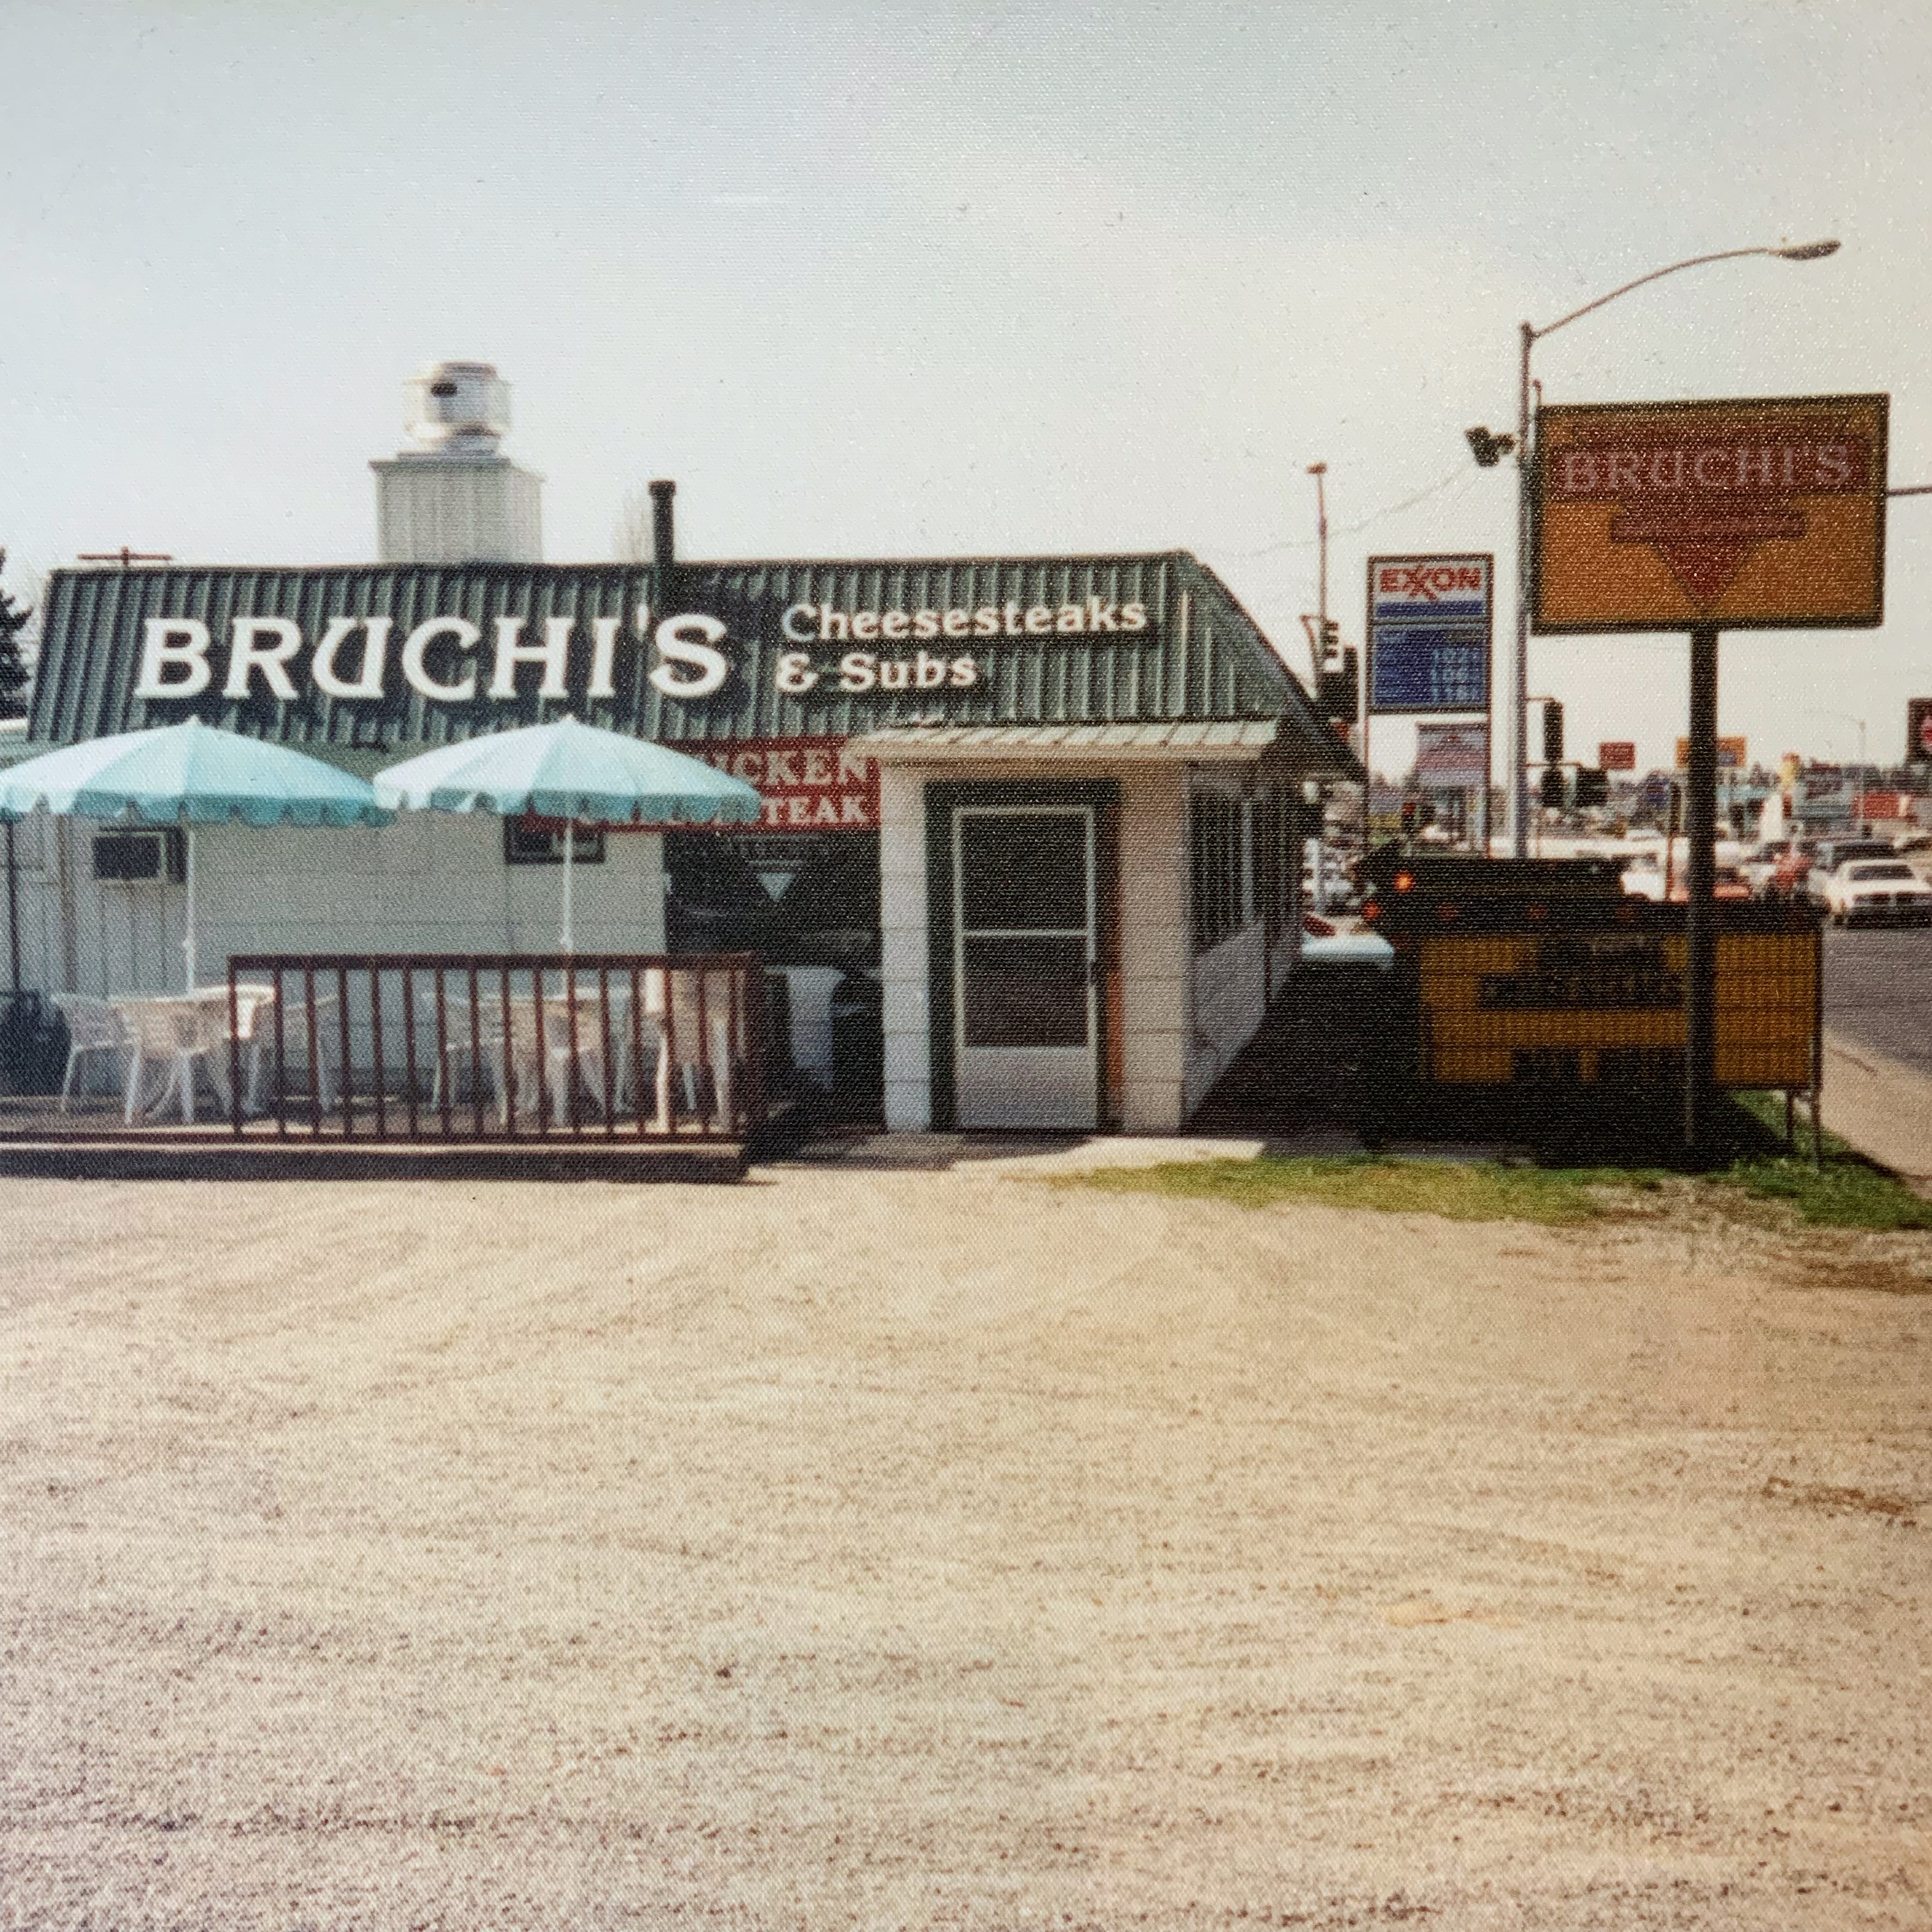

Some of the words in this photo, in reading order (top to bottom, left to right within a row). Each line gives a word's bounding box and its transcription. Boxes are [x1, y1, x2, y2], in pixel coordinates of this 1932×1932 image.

[1563, 443, 1856, 492] BRUCHI'S
[1380, 565, 1480, 601] EXXON
[781, 595, 1148, 640] Cheesesteaks
[134, 603, 728, 700] BRUCHI'S
[775, 652, 818, 693] &
[838, 650, 978, 693] Subs
[709, 749, 868, 786] ICKEN
[760, 795, 868, 825] TEAK
